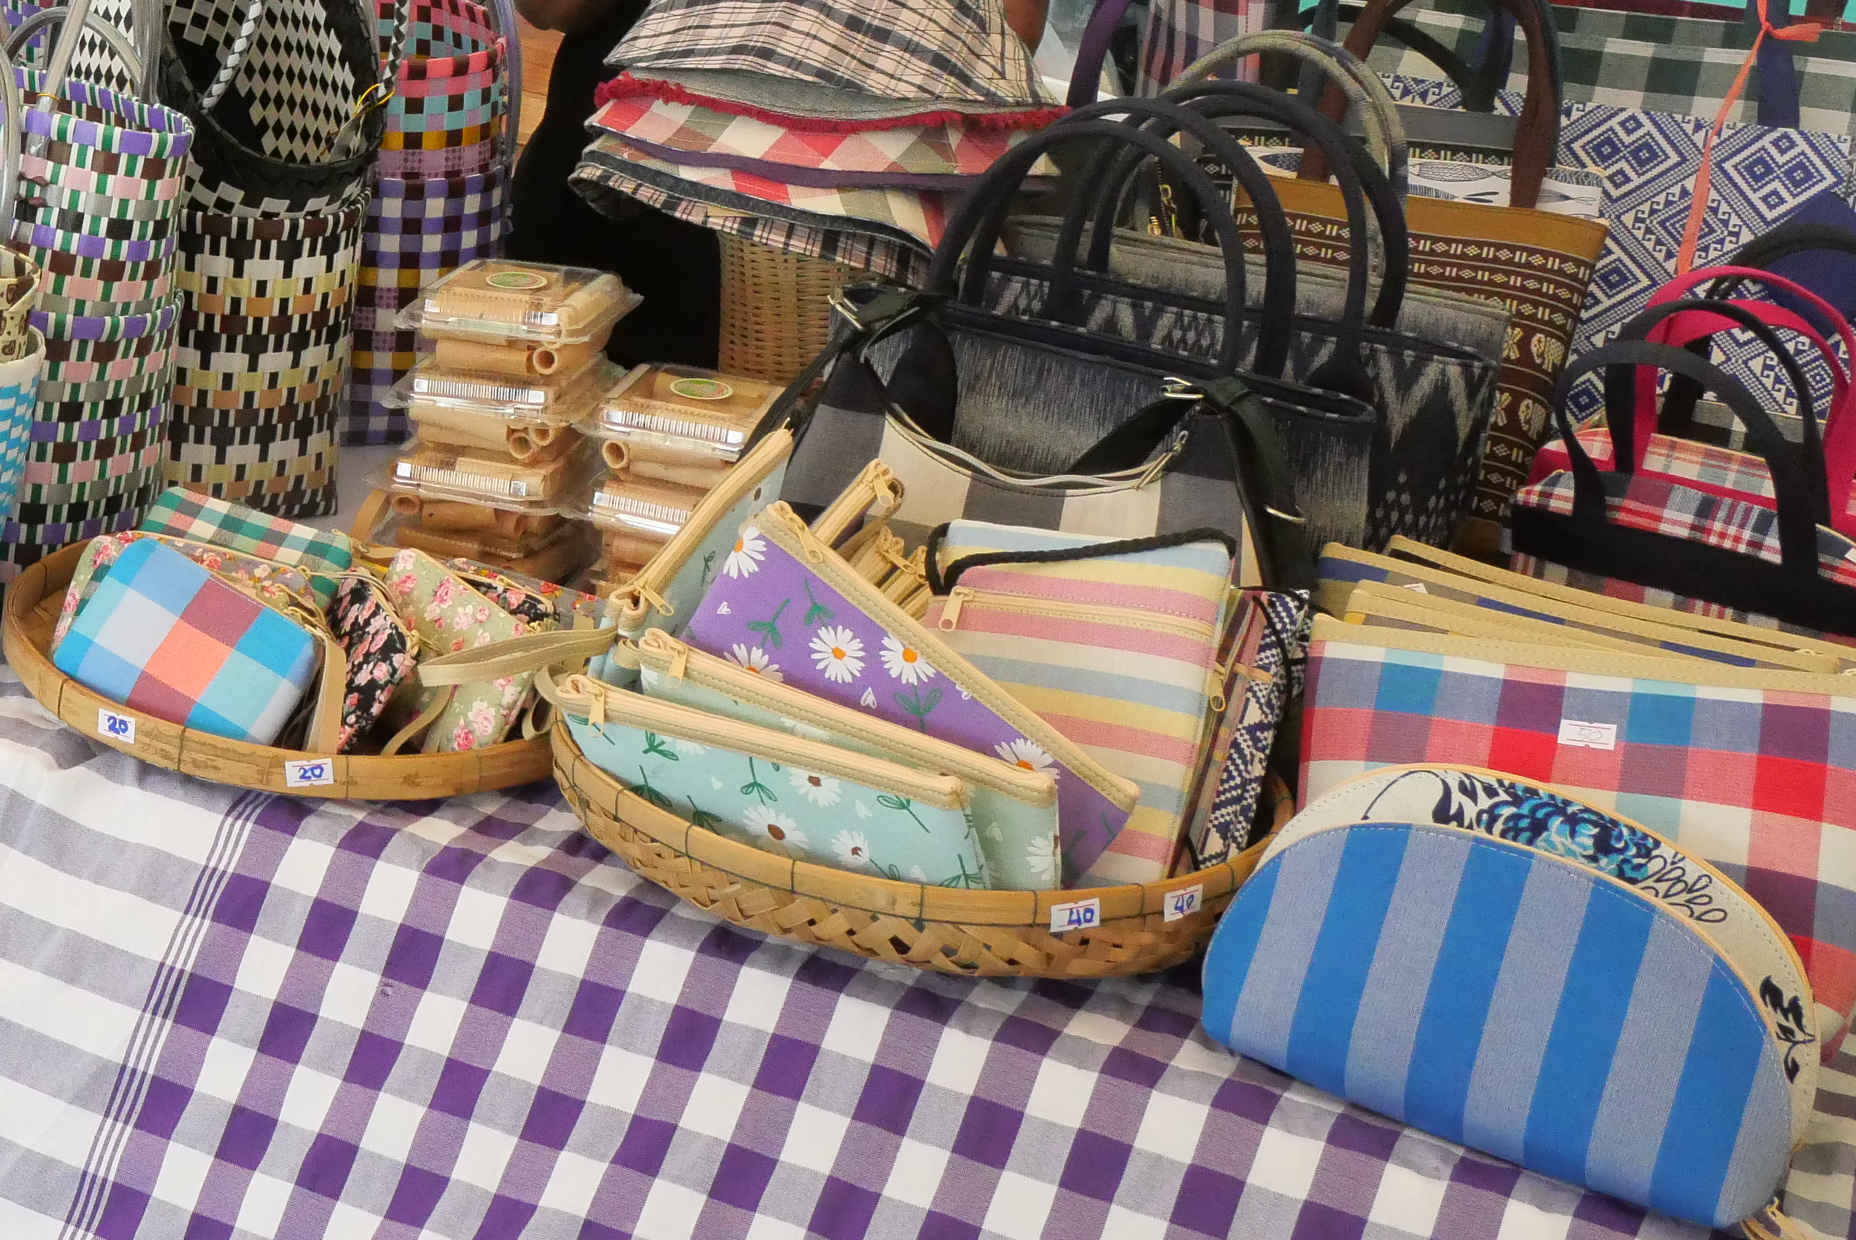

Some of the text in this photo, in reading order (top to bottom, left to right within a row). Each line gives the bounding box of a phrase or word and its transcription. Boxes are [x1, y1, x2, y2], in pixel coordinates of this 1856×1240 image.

[1578, 727, 1603, 742] 50
[297, 765, 324, 781] 20
[1173, 894, 1195, 915] 40
[1067, 907, 1095, 926] 40
